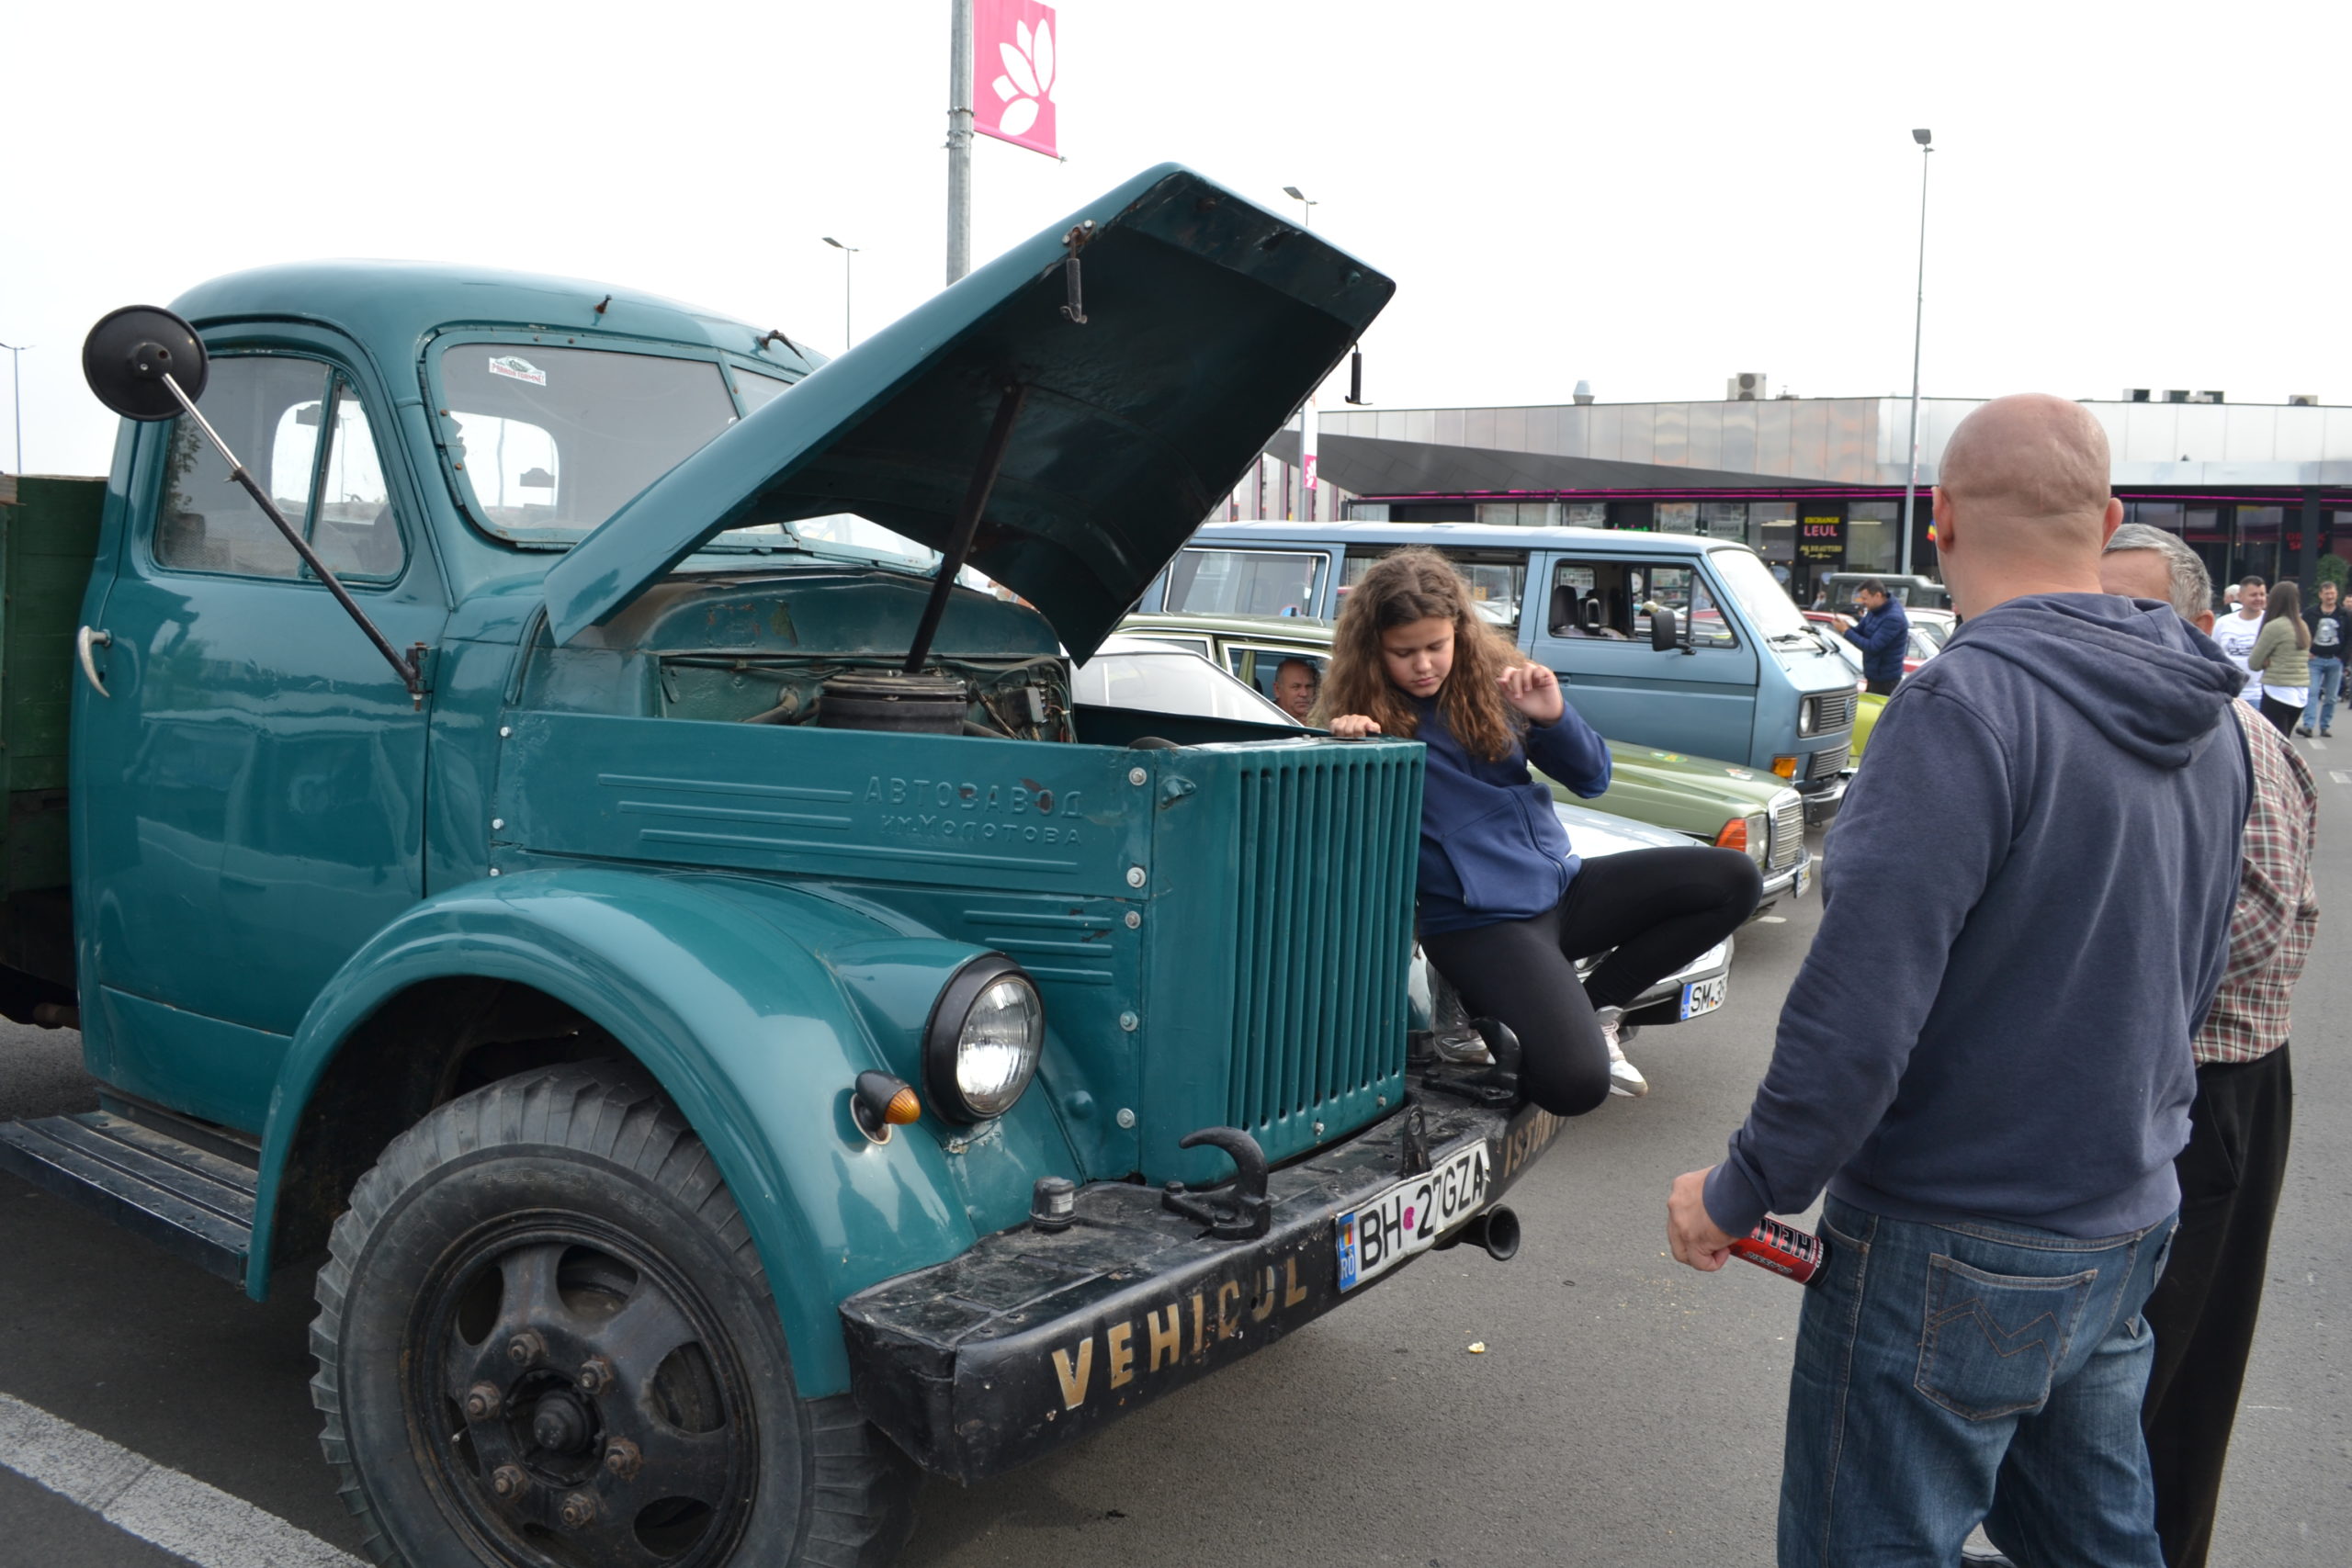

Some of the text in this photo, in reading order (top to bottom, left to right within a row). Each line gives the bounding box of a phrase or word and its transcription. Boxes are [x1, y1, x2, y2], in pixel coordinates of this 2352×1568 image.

[1804, 525, 1838, 537] LEUL
[864, 775, 1085, 819] АВТОЗАВОД
[1690, 983, 1712, 1012] SM
[1359, 1195, 1402, 1271] BH
[1340, 1255, 1355, 1280] RO
[1051, 1256, 1308, 1412] VEHICUL
